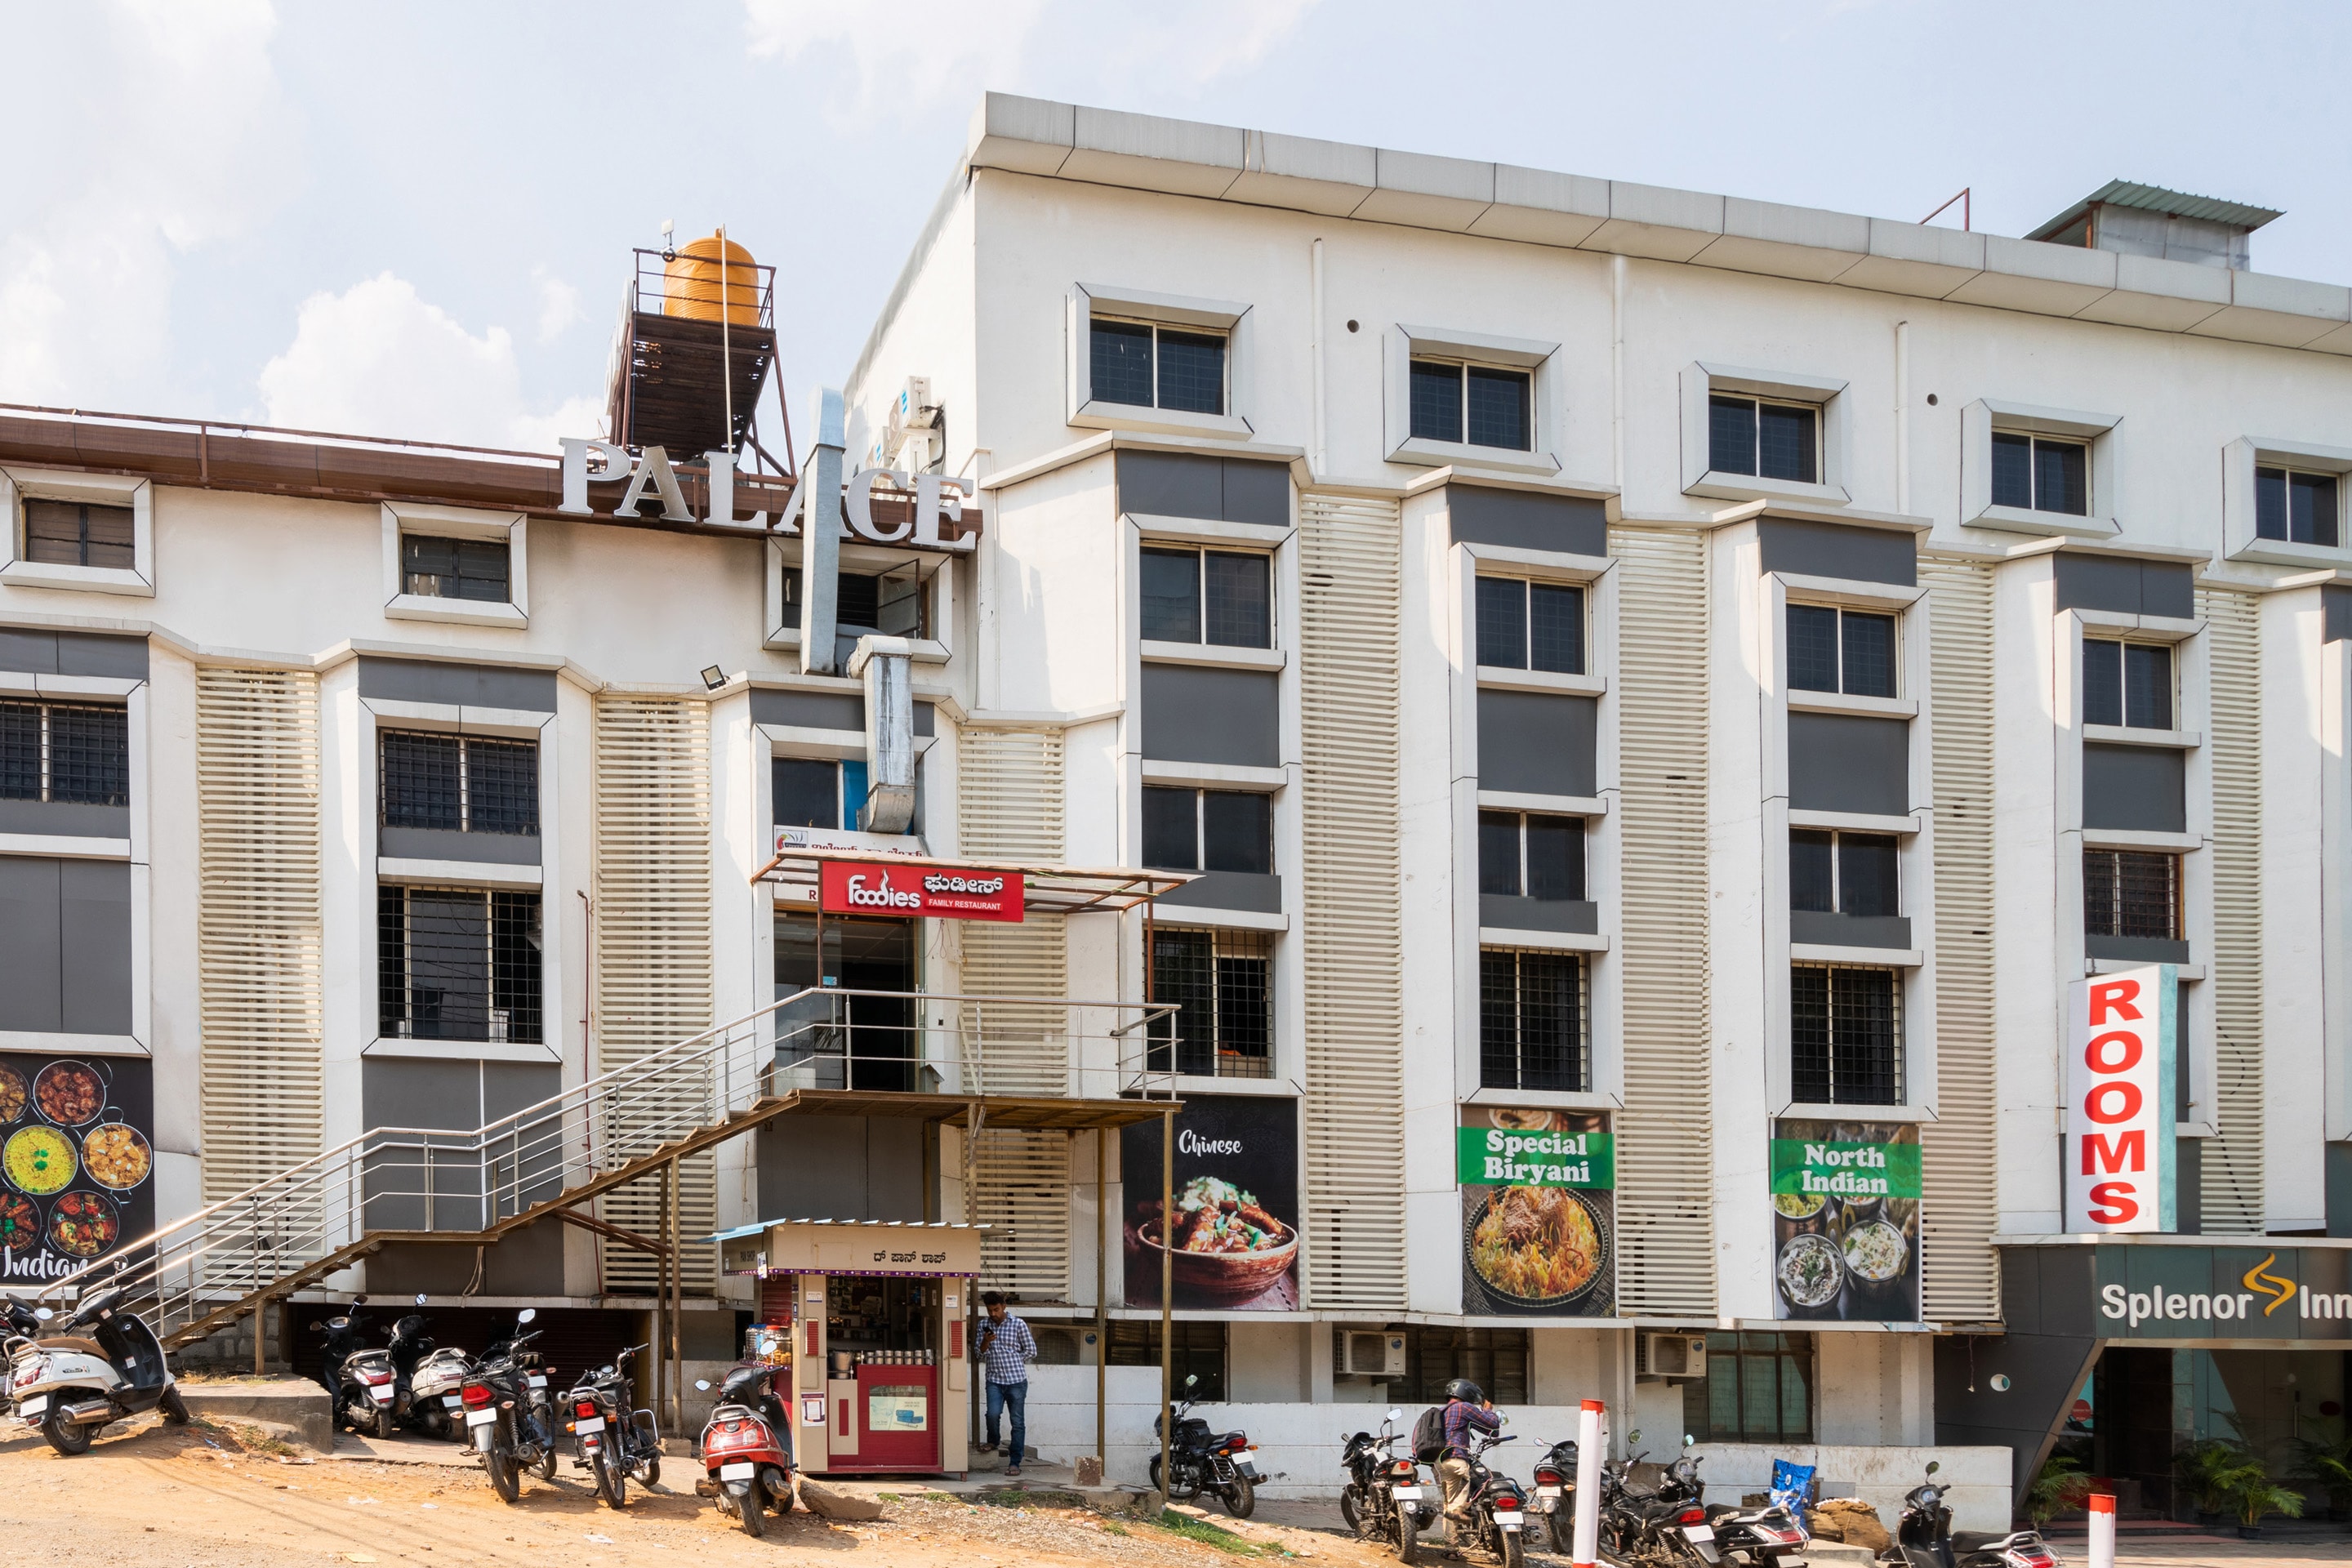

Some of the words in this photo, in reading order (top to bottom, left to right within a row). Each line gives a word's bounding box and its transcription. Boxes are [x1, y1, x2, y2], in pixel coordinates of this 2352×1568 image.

[848, 866, 921, 908] Foodies
[929, 898, 953, 908] FAMILY
[954, 900, 1001, 911] RESTAURANT
[2081, 979, 2146, 1225] ROOMS
[1178, 1129, 1243, 1157] Chinese
[1486, 1129, 1588, 1157] Special
[1804, 1143, 1886, 1168] North
[1484, 1156, 1591, 1185] Biryani
[1802, 1169, 1888, 1194] Indian
[3, 1245, 89, 1280] Indian
[2101, 1284, 2254, 1328] Splenor
[2300, 1285, 2352, 1320] Inn
